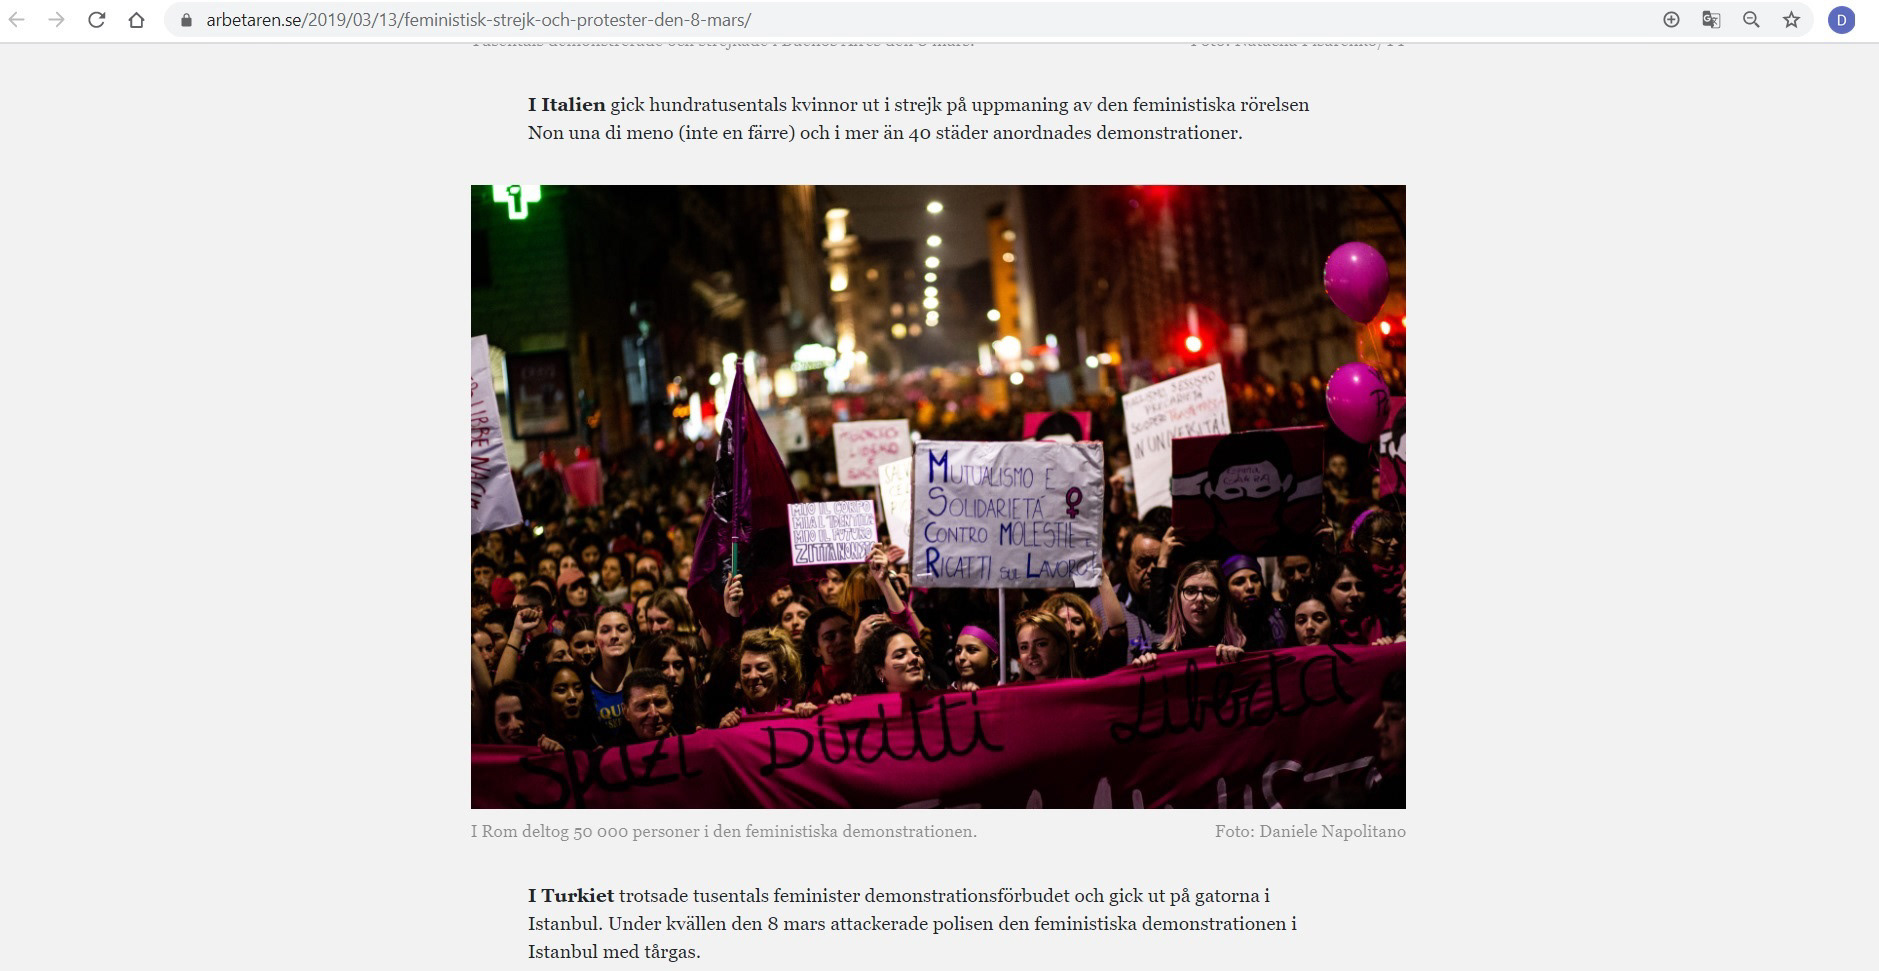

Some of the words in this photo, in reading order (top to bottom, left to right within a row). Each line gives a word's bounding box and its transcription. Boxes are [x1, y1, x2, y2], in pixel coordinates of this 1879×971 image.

[206, 11, 753, 31] arbetaren.se/2019/03/13/feministisk-strejk-och-protester-den-8-mars/
[527, 97, 537, 112] I
[541, 96, 607, 112] Italien
[610, 96, 646, 116] gick
[648, 96, 788, 112] hundratusentals
[790, 96, 859, 112] kvinnor
[861, 98, 880, 112] ut
[884, 96, 891, 112] i
[894, 96, 943, 116] strejk
[946, 96, 968, 116] på
[971, 96, 1069, 116] uppmaning
[1073, 101, 1094, 112] av
[1096, 96, 1129, 112] den
[1132, 96, 1237, 112] feministiska
[1240, 96, 1310, 112] rörelsen
[527, 125, 565, 140] Non
[568, 129, 601, 140] una
[605, 124, 623, 140] di
[626, 129, 674, 140] meno
[678, 124, 719, 143] (inte
[722, 129, 744, 140] en
[747, 124, 796, 143] färre)
[800, 124, 831, 140] och
[834, 124, 841, 140] i
[844, 129, 880, 140] mer
[883, 124, 905, 140] än
[908, 128, 931, 143] 40
[935, 124, 989, 140] städer
[992, 124, 1092, 140] anordnades
[1096, 124, 1243, 140] demonstrationer.
[929, 449, 1034, 488] MUTUALISMO
[1046, 468, 1056, 490] E
[791, 503, 816, 517] MIO
[834, 501, 870, 514] CORPO
[793, 530, 816, 543] MIO
[832, 527, 872, 541] FUTURO
[924, 521, 988, 543] CONTRO
[1000, 521, 1075, 548] MOLESTIE
[925, 546, 992, 580] RICATTI
[470, 824, 478, 838] I
[481, 824, 518, 838] Rom
[521, 823, 570, 842] deltog
[573, 827, 593, 841] 50
[597, 827, 629, 838] 000
[632, 828, 701, 842] personer
[703, 824, 710, 838] i
[712, 823, 742, 838] den
[744, 823, 839, 838] feministiska
[842, 823, 977, 838] demonstrationen.
[1215, 824, 1255, 838] Foto:
[1259, 823, 1318, 838] Daniele
[1320, 823, 1407, 842] Napolitano
[527, 888, 537, 903] I
[540, 887, 616, 903] Turkiet
[618, 887, 689, 903] trotsade
[692, 887, 770, 903] tusentals
[773, 887, 861, 903] feminister
[864, 887, 1071, 903] demonstrationsförbudet
[1074, 887, 1105, 903] och
[1108, 887, 1145, 907] gick
[1147, 889, 1166, 903] ut
[1169, 887, 1191, 907] på
[1194, 889, 1261, 907] gatorna
[1263, 887, 1271, 903] i
[527, 915, 603, 931] Istanbul.
[608, 915, 662, 931] Under
[665, 915, 727, 931] kvällen
[731, 915, 764, 931] den
[767, 916, 779, 931] 8
[783, 920, 826, 931] mars
[830, 915, 929, 931] attackerade
[932, 915, 995, 935] polisen
[998, 915, 1030, 931] den
[1033, 915, 1138, 931] feministiska
[1141, 915, 1287, 931] demonstrationen
[1290, 915, 1298, 931] i
[527, 943, 599, 959] Istanbul
[602, 943, 640, 959] med
[643, 943, 701, 963] tårgas.
